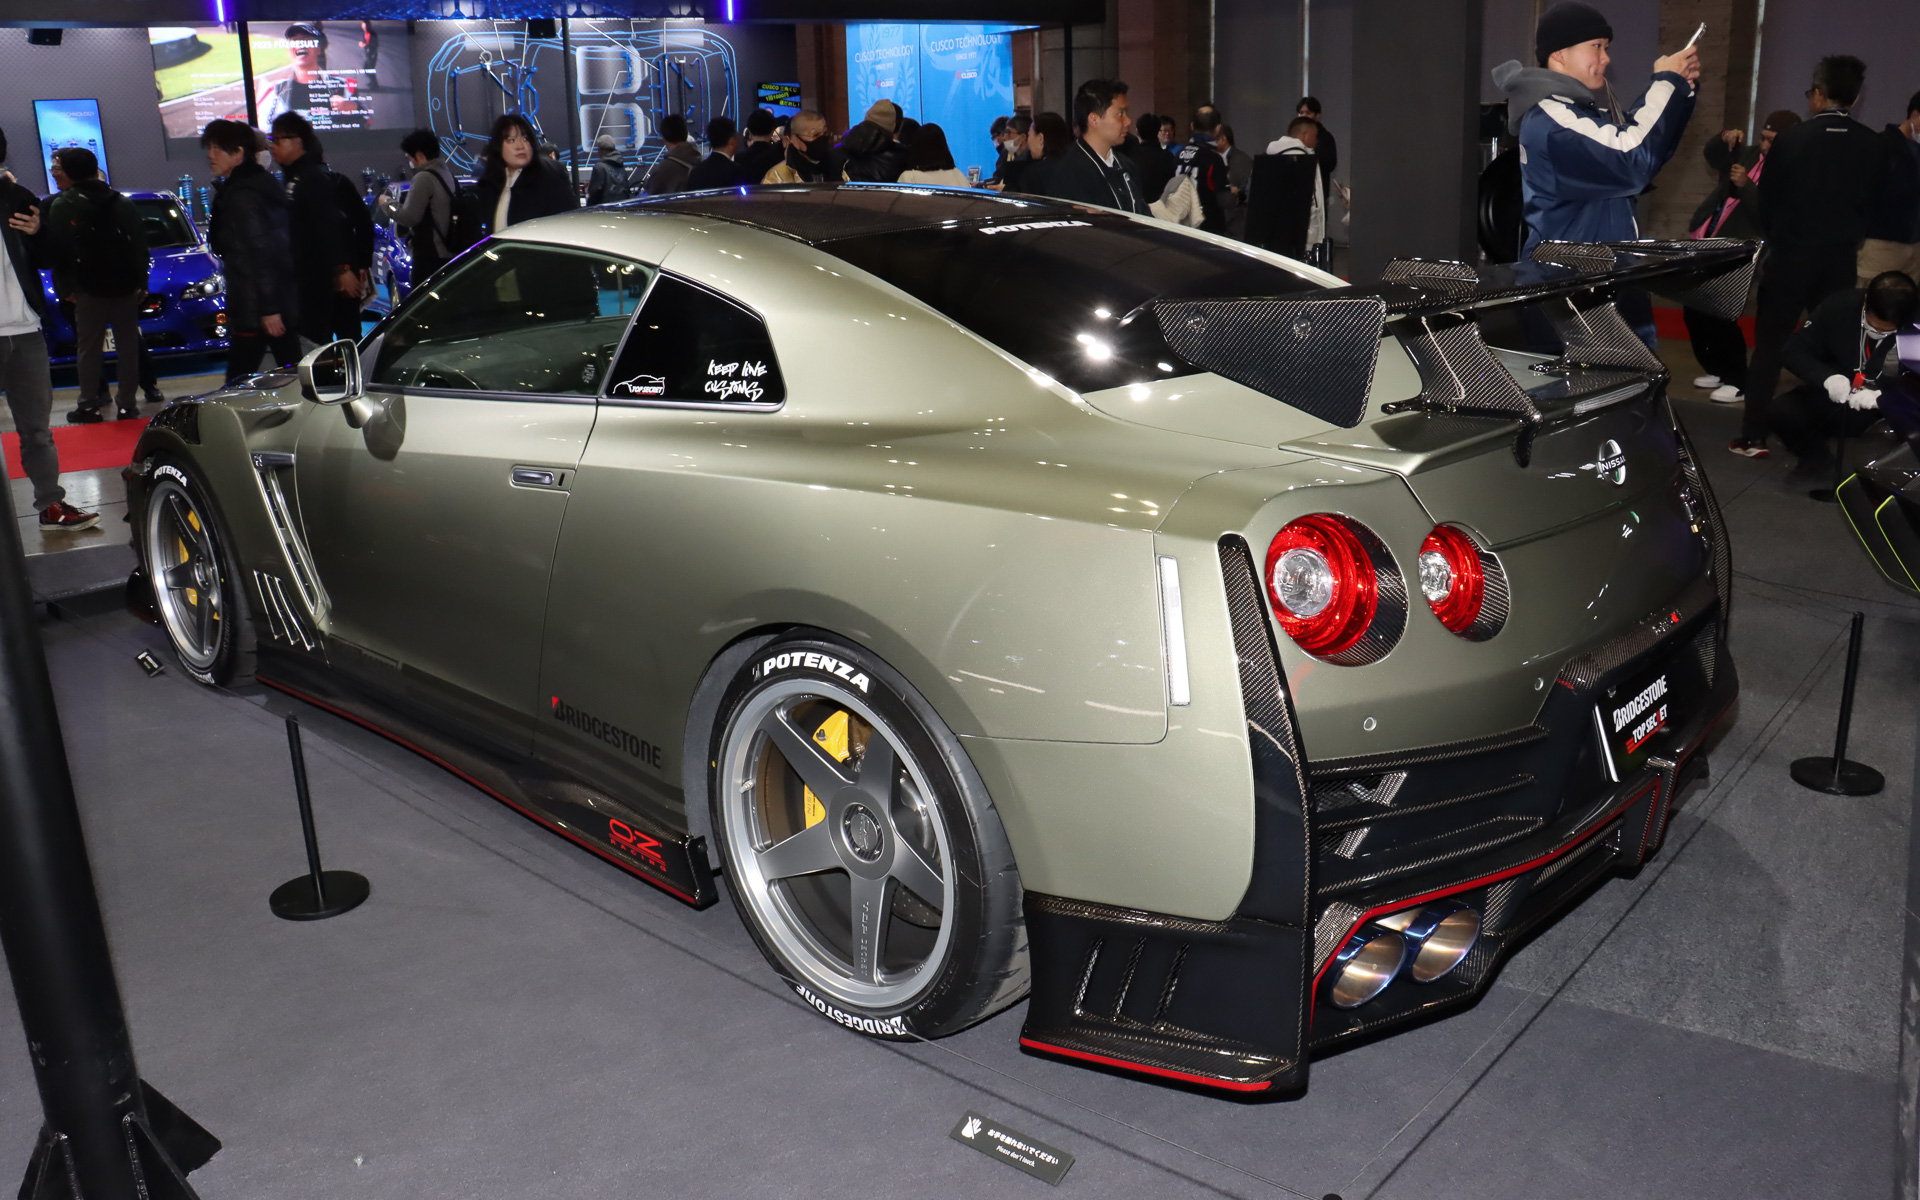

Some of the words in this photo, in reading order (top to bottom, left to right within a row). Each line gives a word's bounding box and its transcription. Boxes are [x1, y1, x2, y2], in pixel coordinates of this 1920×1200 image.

[290, 39, 320, 48] RESULT
[854, 50, 875, 63] CUSCO
[875, 45, 914, 60] TECHNOLOGY
[930, 39, 954, 52] CUSCO
[955, 34, 1001, 49] TECHNOLOGY
[978, 220, 1093, 235] POTENZA
[707, 359, 739, 377] KEEP
[153, 465, 187, 487] POTENZA
[763, 652, 870, 694] POTENZA
[1612, 674, 1668, 733] BRIDGESTONE
[552, 696, 662, 770] BRIDGESTONE
[1632, 722, 1646, 744] TOP
[796, 985, 908, 1036] BRIDGESTONE
[987, 1129, 1059, 1165] お手を触れないでください
[996, 1145, 1010, 1156] Please
